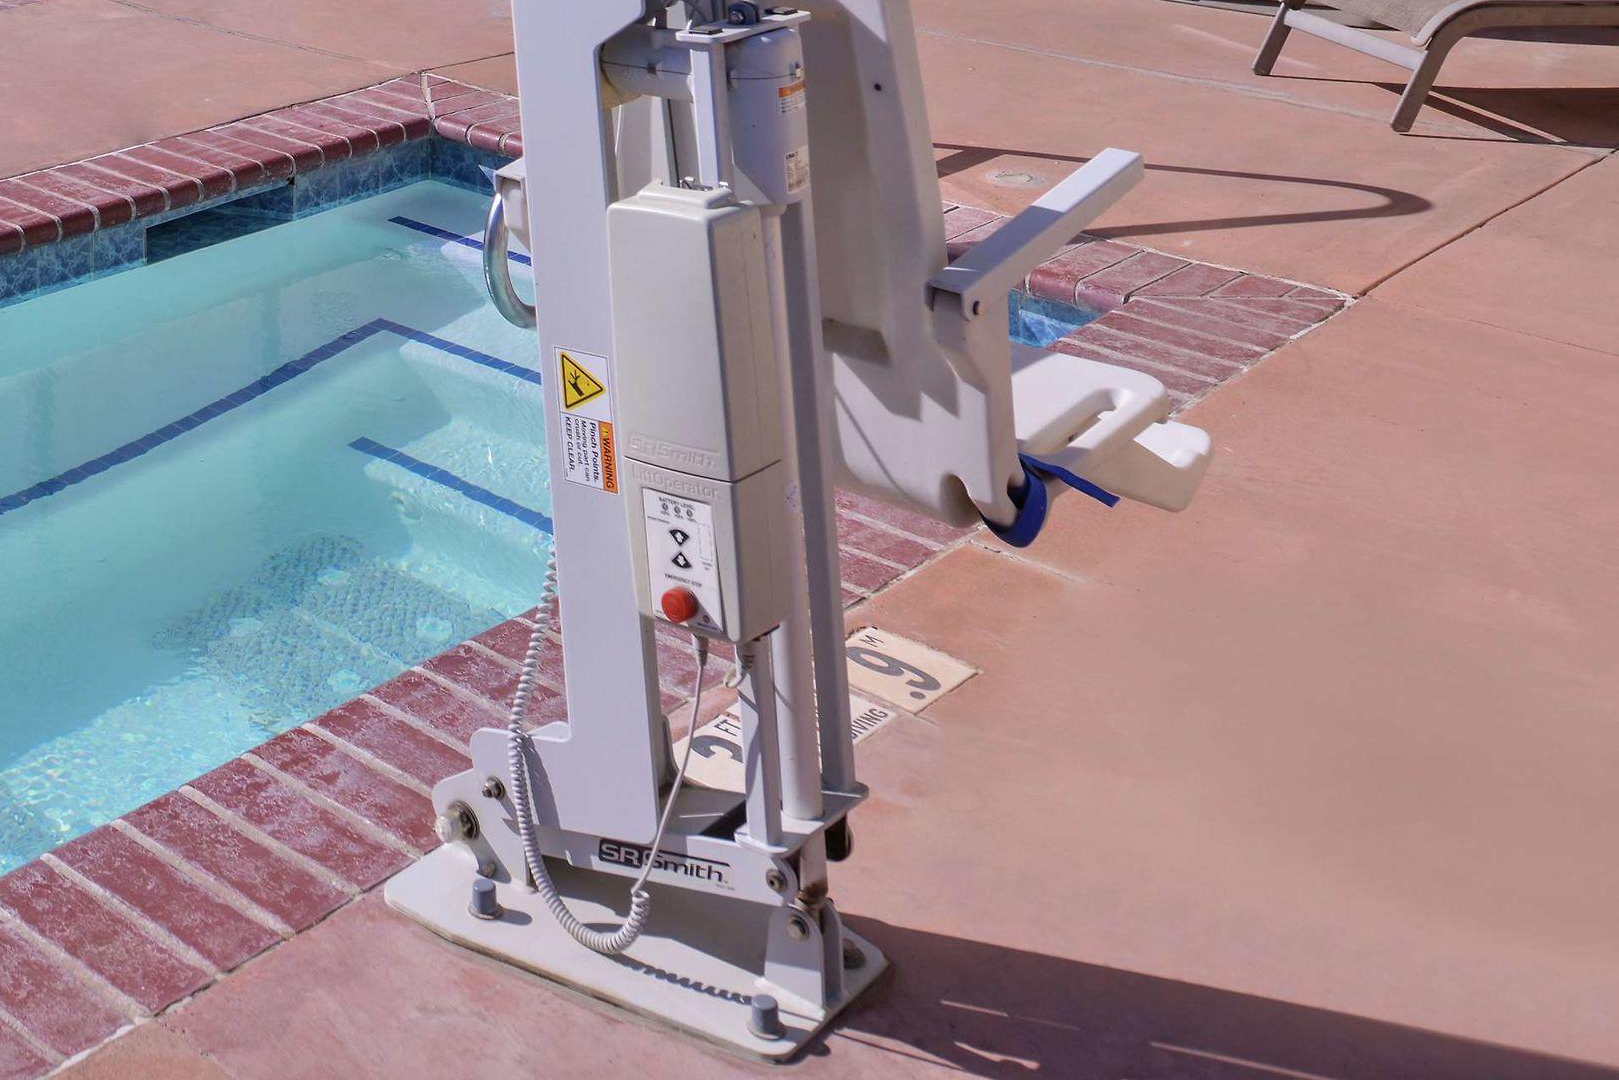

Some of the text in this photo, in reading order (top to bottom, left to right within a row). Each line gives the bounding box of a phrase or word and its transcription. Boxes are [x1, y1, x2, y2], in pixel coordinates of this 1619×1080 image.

[566, 416, 574, 440] KEEP
[590, 422, 598, 449] Pinch
[603, 437, 615, 489] WARNING
[714, 719, 742, 737] FT
